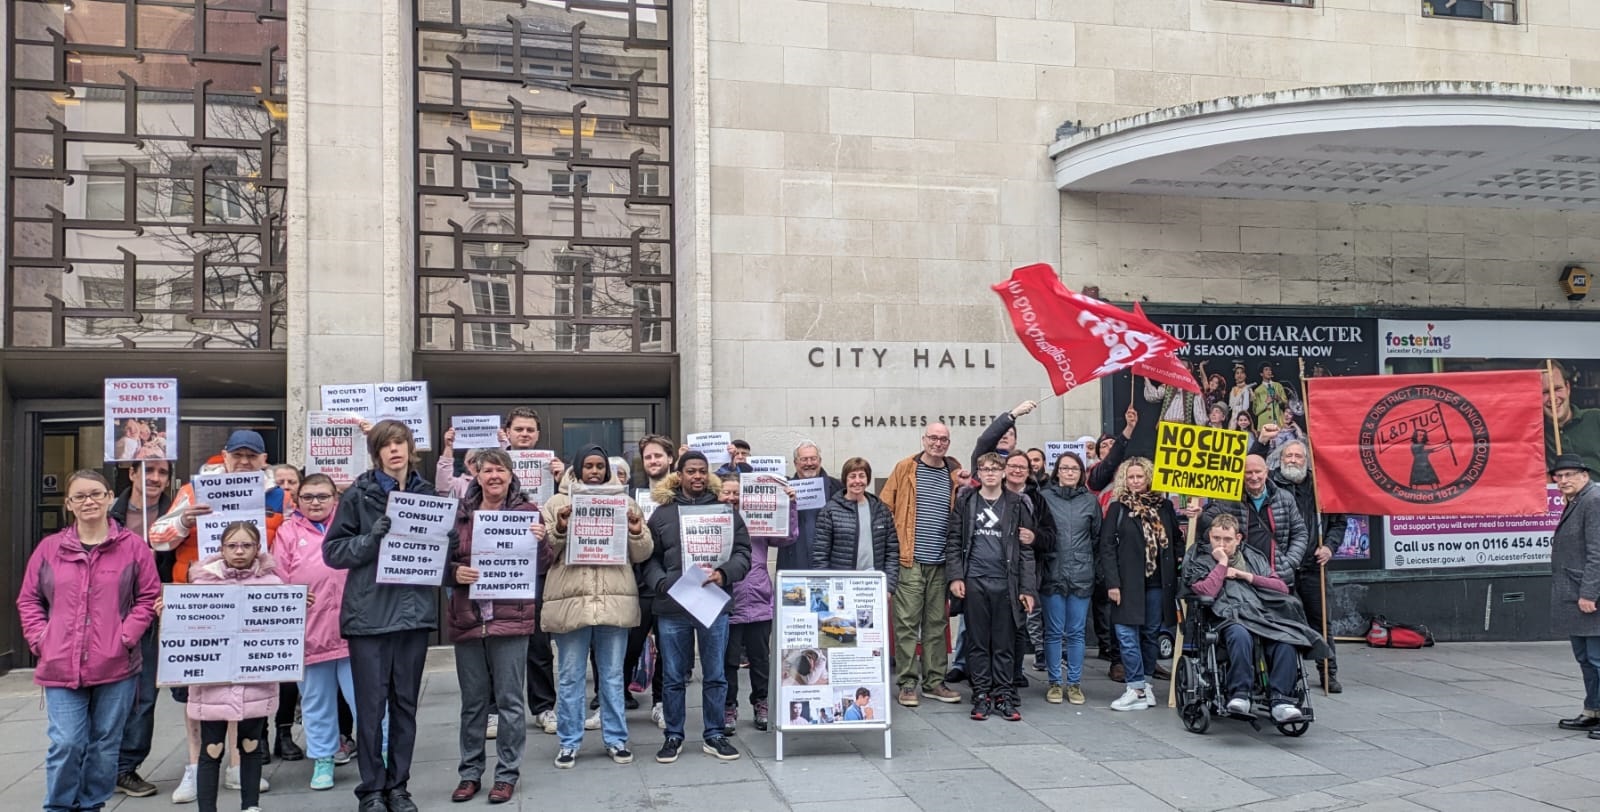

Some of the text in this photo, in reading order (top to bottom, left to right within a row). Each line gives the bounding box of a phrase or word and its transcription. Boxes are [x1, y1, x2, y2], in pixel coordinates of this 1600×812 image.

[1161, 324, 1363, 342] FULL OF CHARACTER
[1386, 332, 1451, 350] fostering
[1172, 344, 1332, 356] EW SEASON ON SALE NOW
[808, 347, 996, 368] CITY HALL
[1416, 387, 1460, 405] TRADES
[1370, 389, 1412, 420] DISTRICT
[809, 415, 996, 428] 115 CHARLES STREET
[1460, 402, 1486, 436] UNION
[311, 427, 352, 436] NO CUTS!
[1380, 410, 1440, 444] L&D TUC
[312, 438, 333, 446] FUND
[1162, 425, 1246, 456] NO CUTS
[312, 446, 351, 456] SERVICES
[315, 457, 336, 465] Tories
[1160, 447, 1244, 473] TO SEND
[1362, 431, 1388, 485] LEICESTER
[1462, 438, 1488, 484] COUNCIL
[518, 460, 542, 469] CUTS!
[200, 476, 260, 487] YOU DIDN'T
[1158, 468, 1240, 496] TRANSPORT!
[208, 490, 254, 500] CONSULT
[743, 486, 776, 494] NO CUTS!
[1392, 485, 1459, 500] Founded 1872
[394, 497, 453, 510] YOU DIDN'T
[592, 498, 626, 506] Socialist
[222, 504, 240, 512] ME!
[576, 507, 614, 517] NO CUTS!
[398, 511, 444, 522] CONSULT
[410, 526, 428, 534] ME!
[576, 527, 613, 536] SERVICES
[686, 526, 722, 535] NO CUTS!
[1409, 523, 1436, 532] support
[1437, 523, 1450, 531] you
[403, 542, 426, 550] CUTS
[578, 537, 598, 545] Tories
[1394, 541, 1418, 552] Call
[1422, 542, 1434, 552] us
[1438, 542, 1462, 551] now
[1464, 541, 1480, 550] on
[1482, 538, 1508, 550] 0116
[1512, 537, 1533, 548] 454
[1406, 555, 1466, 565] Leicester.gov.uk
[384, 567, 438, 576] TRANSPORT!
[244, 618, 304, 626] TRANSPORT!
[161, 638, 230, 648] YOU DIDN'T
[168, 653, 222, 662] CONSULT
[240, 664, 299, 672] TRANSPORT!
[184, 669, 204, 678] ME!
